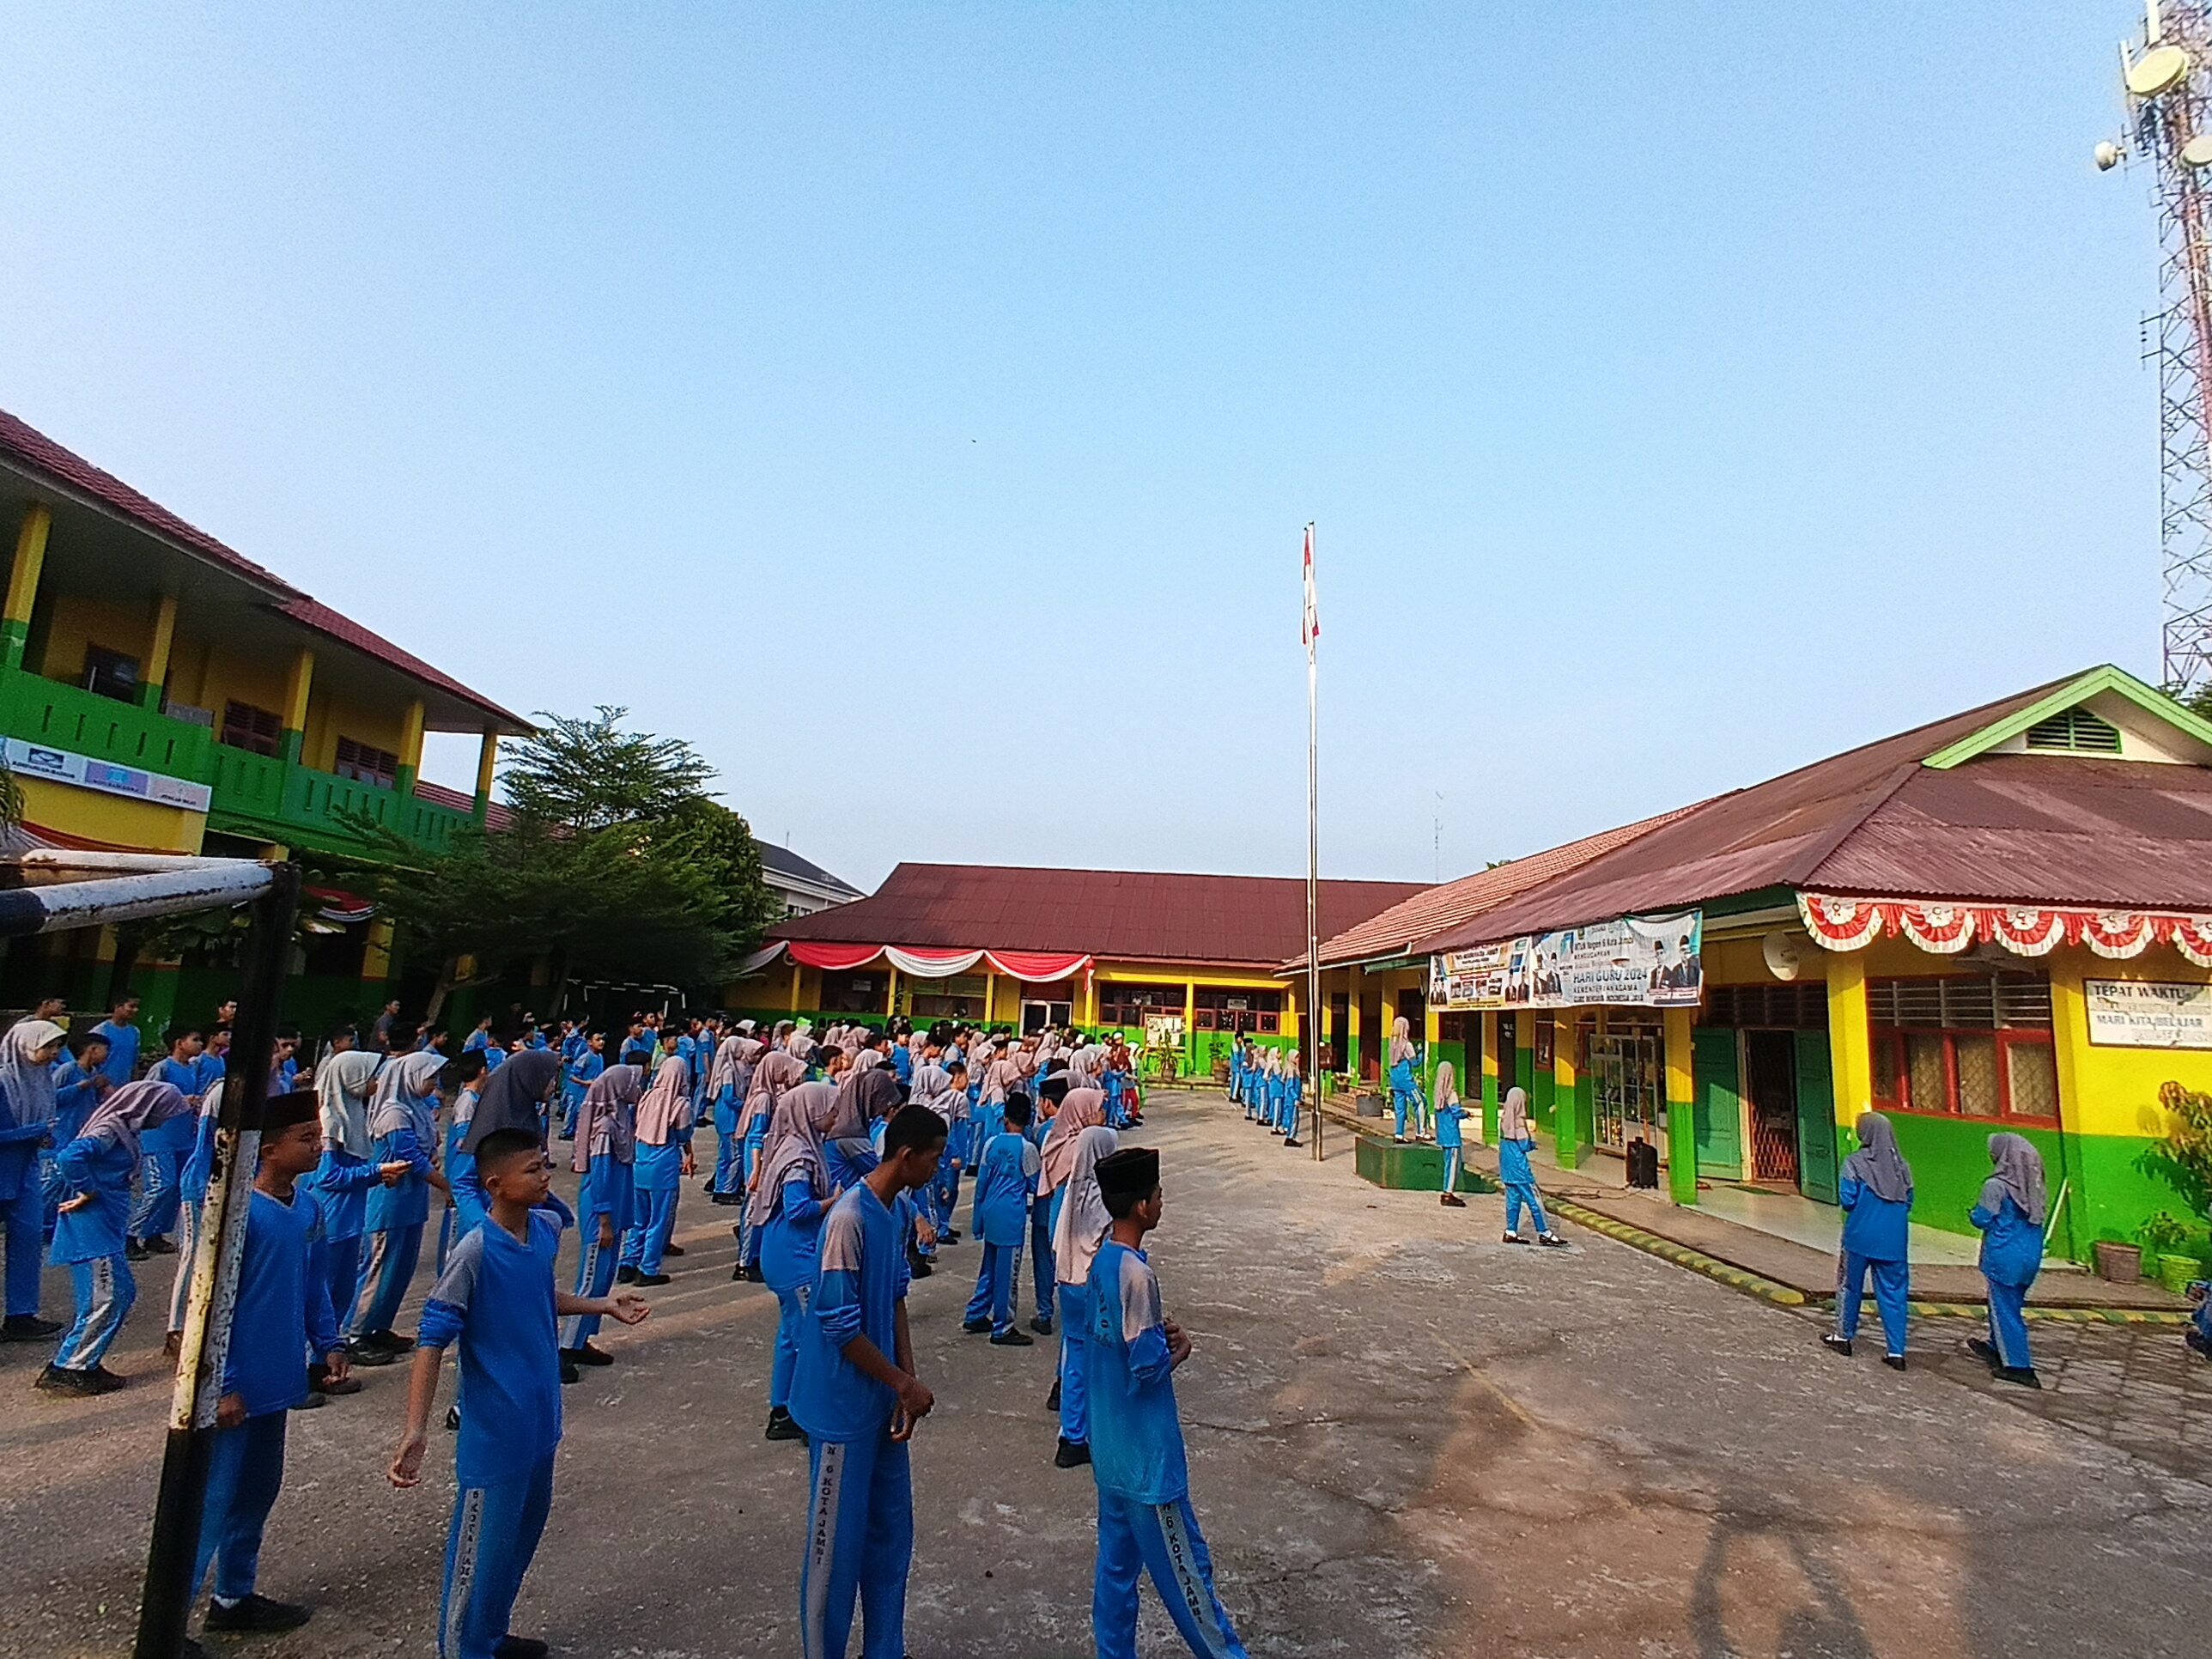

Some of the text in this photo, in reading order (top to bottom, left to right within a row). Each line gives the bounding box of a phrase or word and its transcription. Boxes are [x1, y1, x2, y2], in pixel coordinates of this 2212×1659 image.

[1573, 968, 1648, 983] HARI GURU 2024
[2094, 985, 2185, 1000] TEPAT WAKTU
[2096, 1014, 2126, 1025] MARI
[2129, 1016, 2152, 1026] KITA
[819, 1478, 833, 1516] KOTA
[1165, 1516, 1174, 1529] 6
[817, 1519, 827, 1565] JAMBI
[1169, 1532, 1188, 1573] KOTA
[1183, 1576, 1203, 1624] JAMBI
